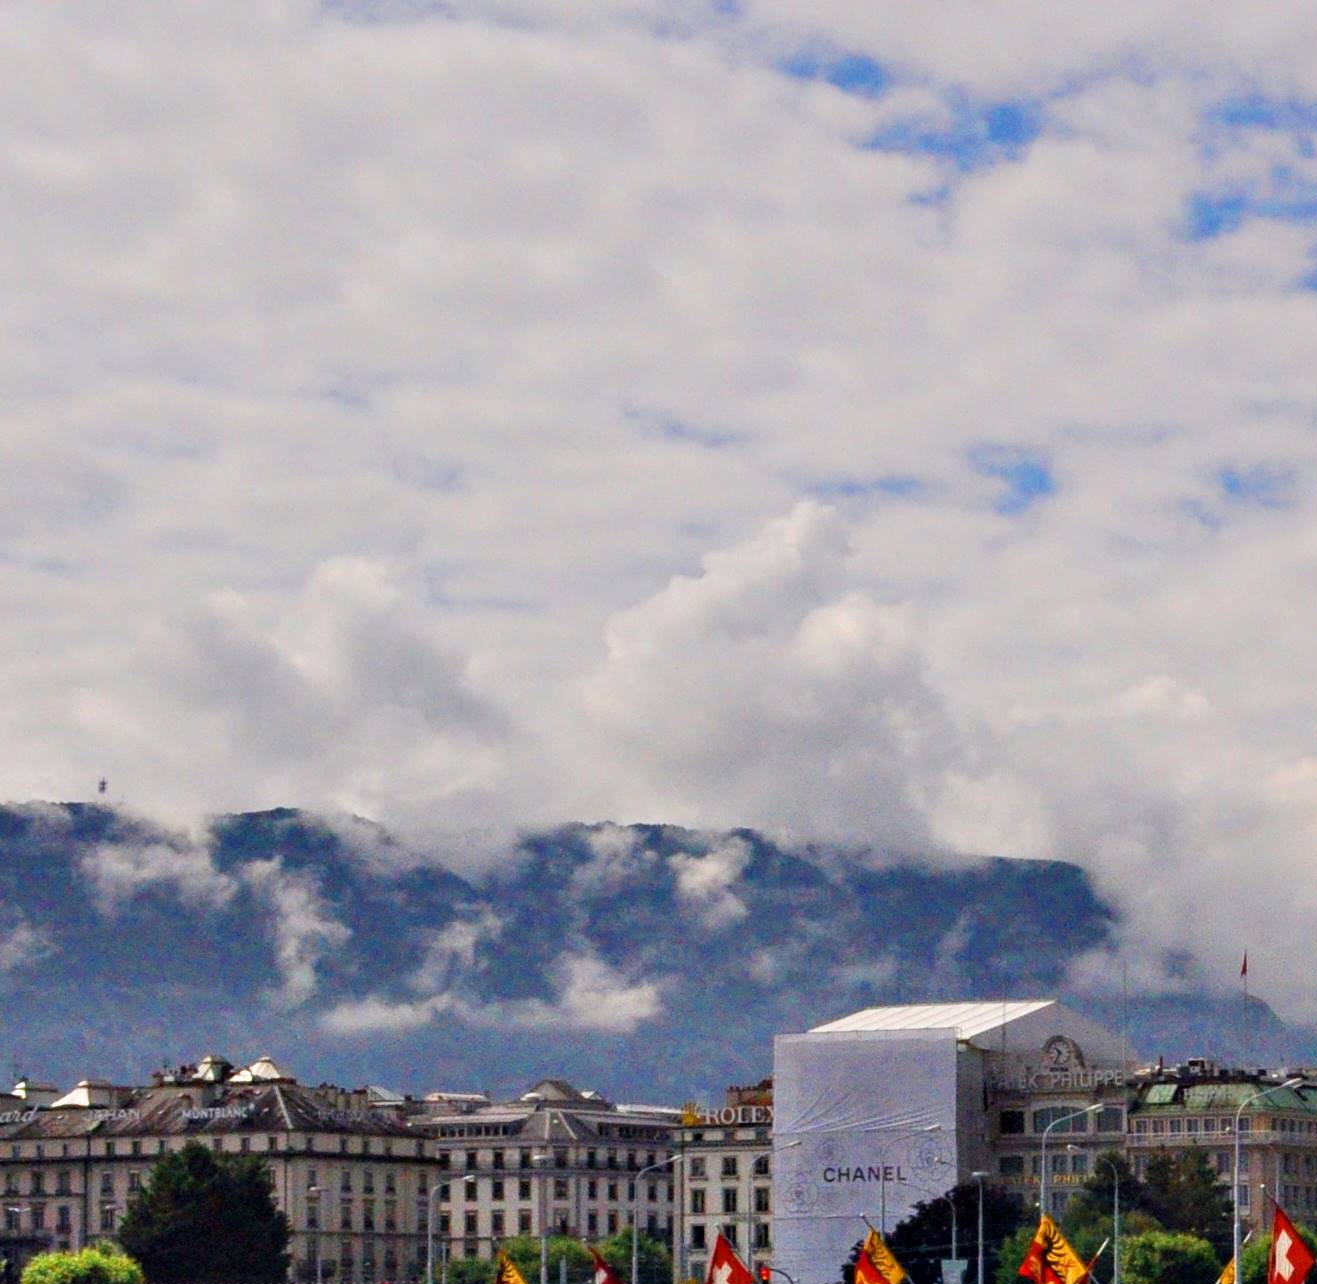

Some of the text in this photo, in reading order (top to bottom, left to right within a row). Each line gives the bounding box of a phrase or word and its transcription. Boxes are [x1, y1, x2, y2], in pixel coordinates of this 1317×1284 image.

[1051, 1070, 1122, 1088] PHILIPPE
[182, 1106, 248, 1119] MONTBLANC
[823, 1166, 907, 1183] CHANEL
